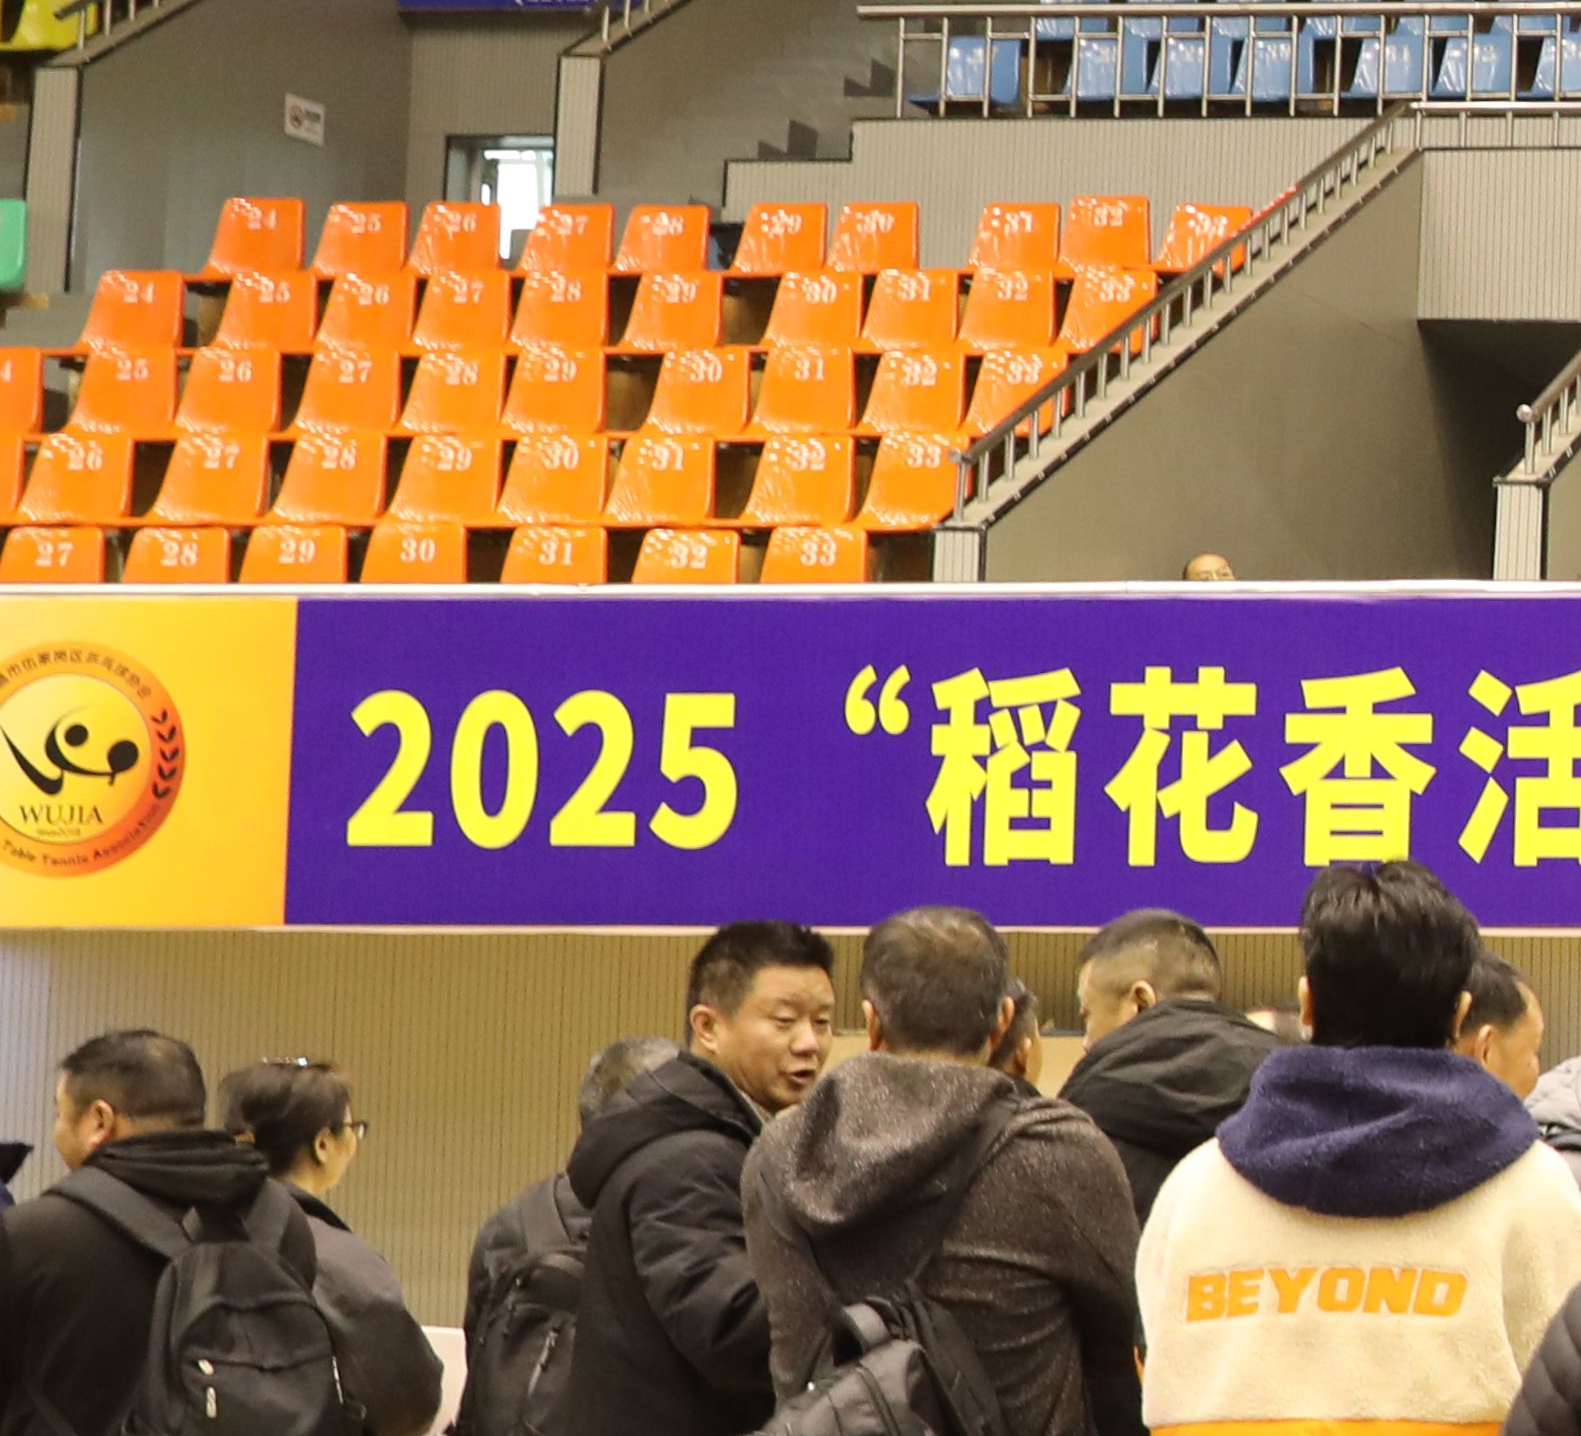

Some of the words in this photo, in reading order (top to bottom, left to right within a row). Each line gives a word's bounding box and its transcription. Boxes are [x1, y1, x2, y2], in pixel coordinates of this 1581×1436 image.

[124, 284, 153, 303] 24
[118, 361, 148, 380] 25
[221, 361, 251, 381] 26
[340, 362, 371, 382] 27
[545, 361, 576, 381] 29
[796, 361, 823, 380] 31
[70, 448, 102, 470] 26
[206, 447, 238, 468] 27
[324, 447, 356, 469] 28
[546, 447, 578, 469] 30
[37, 543, 72, 566] 27
[162, 543, 197, 566] 28
[280, 540, 315, 563] 29
[401, 539, 435, 562] 30
[540, 542, 572, 564] 31
[670, 546, 706, 568] 32
[801, 543, 836, 565] 33
[347, 691, 737, 848] 2025
[19, 804, 103, 825] WUJIA
[1187, 1266, 1468, 1322] BEYOND
